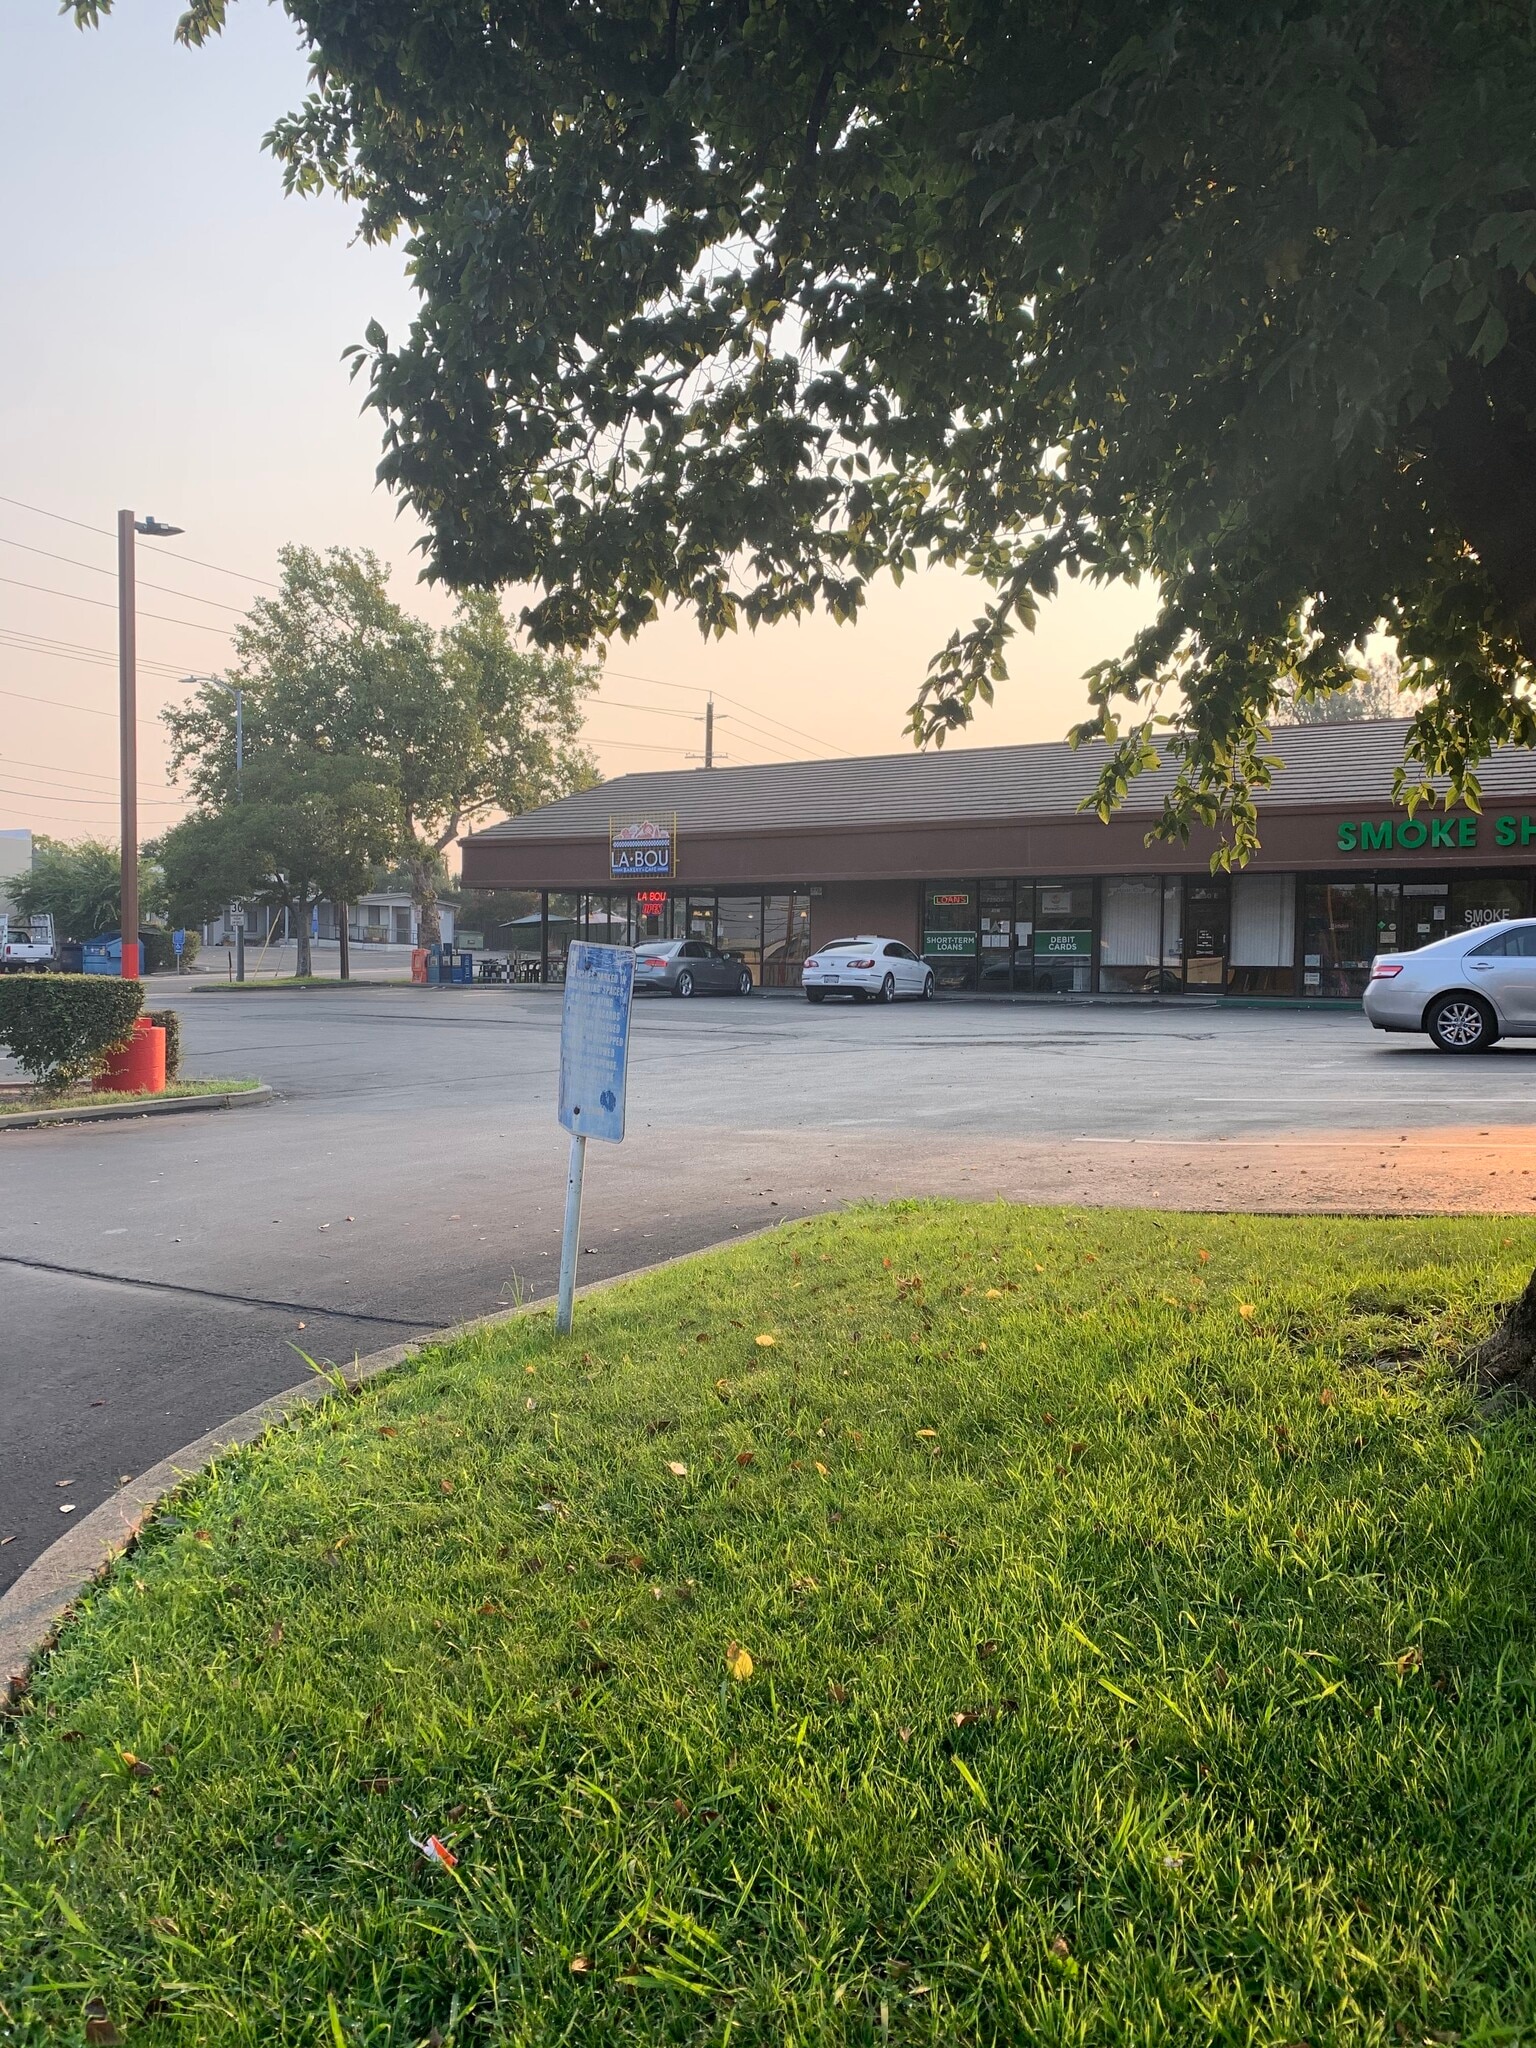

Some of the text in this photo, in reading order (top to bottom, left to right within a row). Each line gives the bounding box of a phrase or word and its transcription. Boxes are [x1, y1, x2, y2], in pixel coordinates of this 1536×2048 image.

[1337, 817, 1478, 851] SMOKE
[936, 896, 966, 904] LOANS
[1464, 908, 1511, 923] SMOKE
[1050, 936, 1075, 944] DEBIT
[937, 943, 963, 951] LOANS
[1048, 943, 1077, 951] CARDS
[602, 985, 624, 997] SPACES
